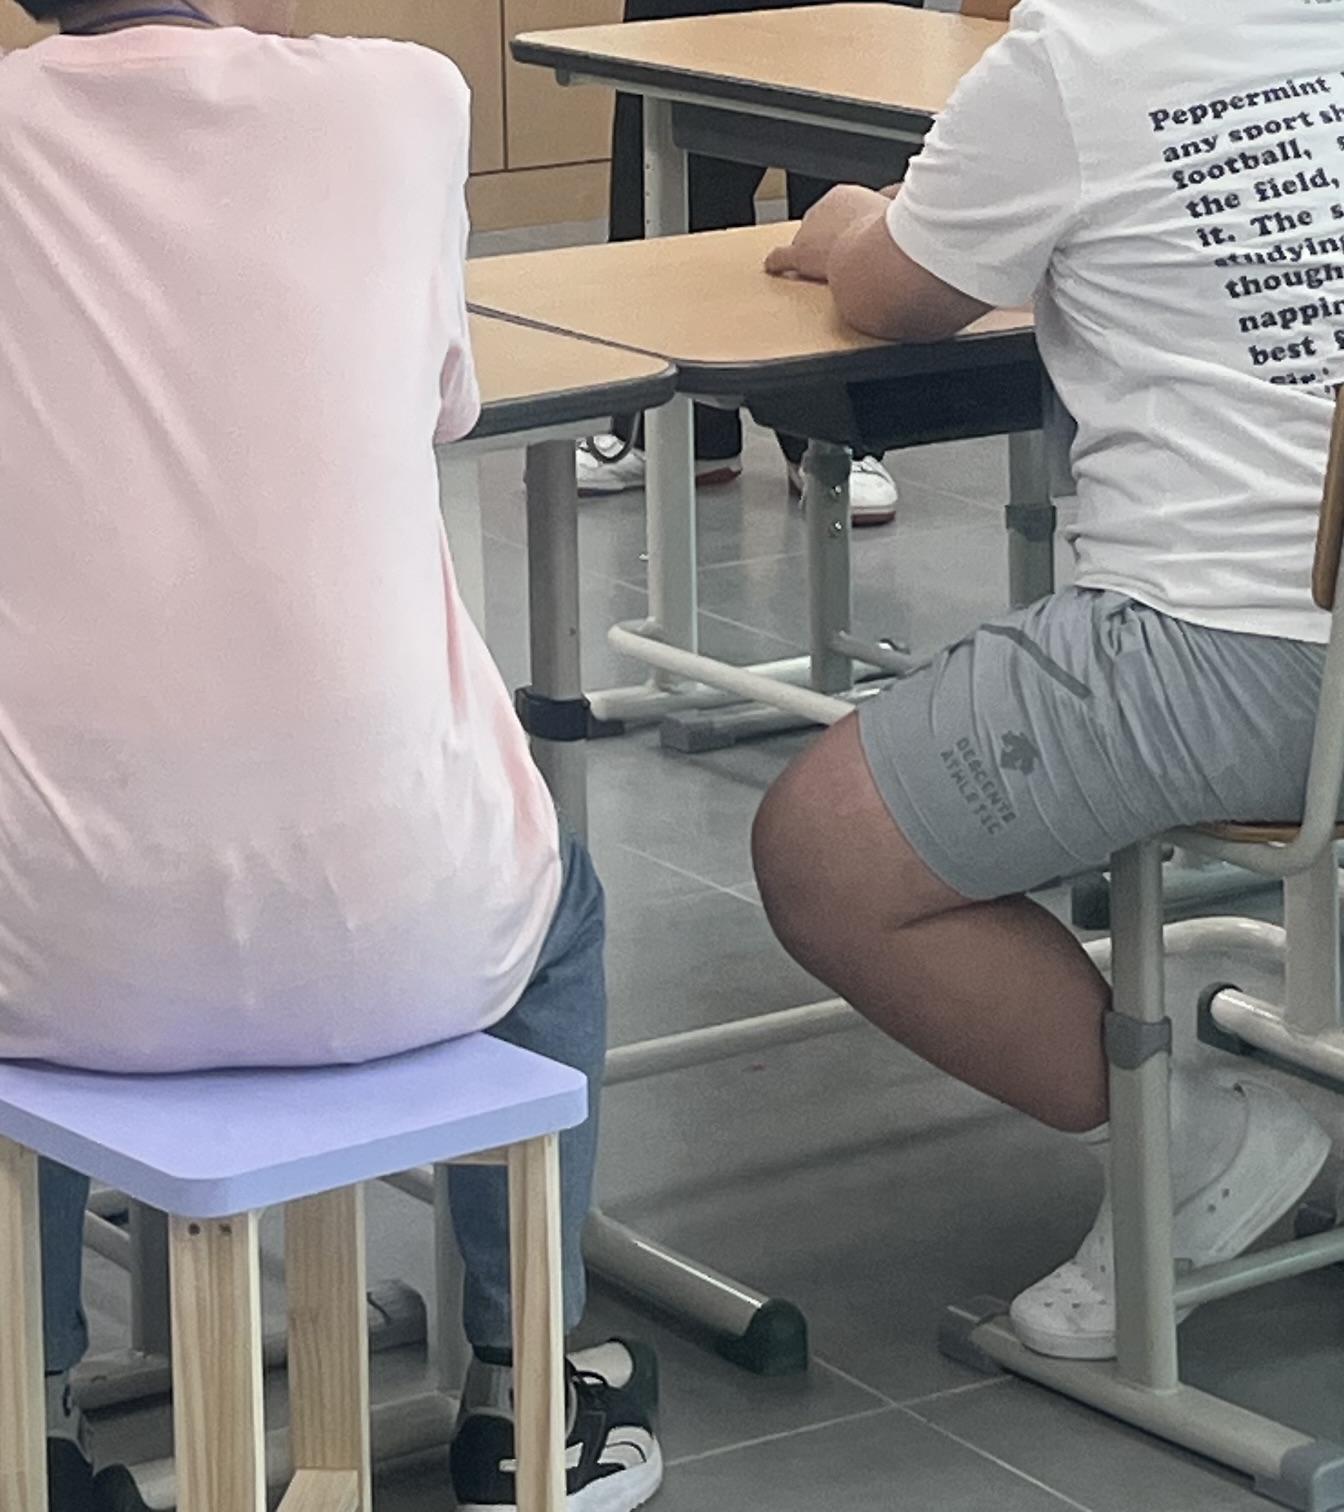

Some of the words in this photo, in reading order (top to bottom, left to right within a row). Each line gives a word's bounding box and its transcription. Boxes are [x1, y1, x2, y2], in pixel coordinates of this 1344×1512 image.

[1149, 75, 1331, 131] Peppermint
[1163, 135, 1219, 162] any
[1228, 111, 1315, 142] sport
[1172, 138, 1313, 190] football,
[1186, 192, 1241, 219] the
[1253, 167, 1341, 202] field,
[1196, 227, 1236, 247] it.
[1250, 210, 1313, 237] The
[1248, 336, 1317, 366] best
